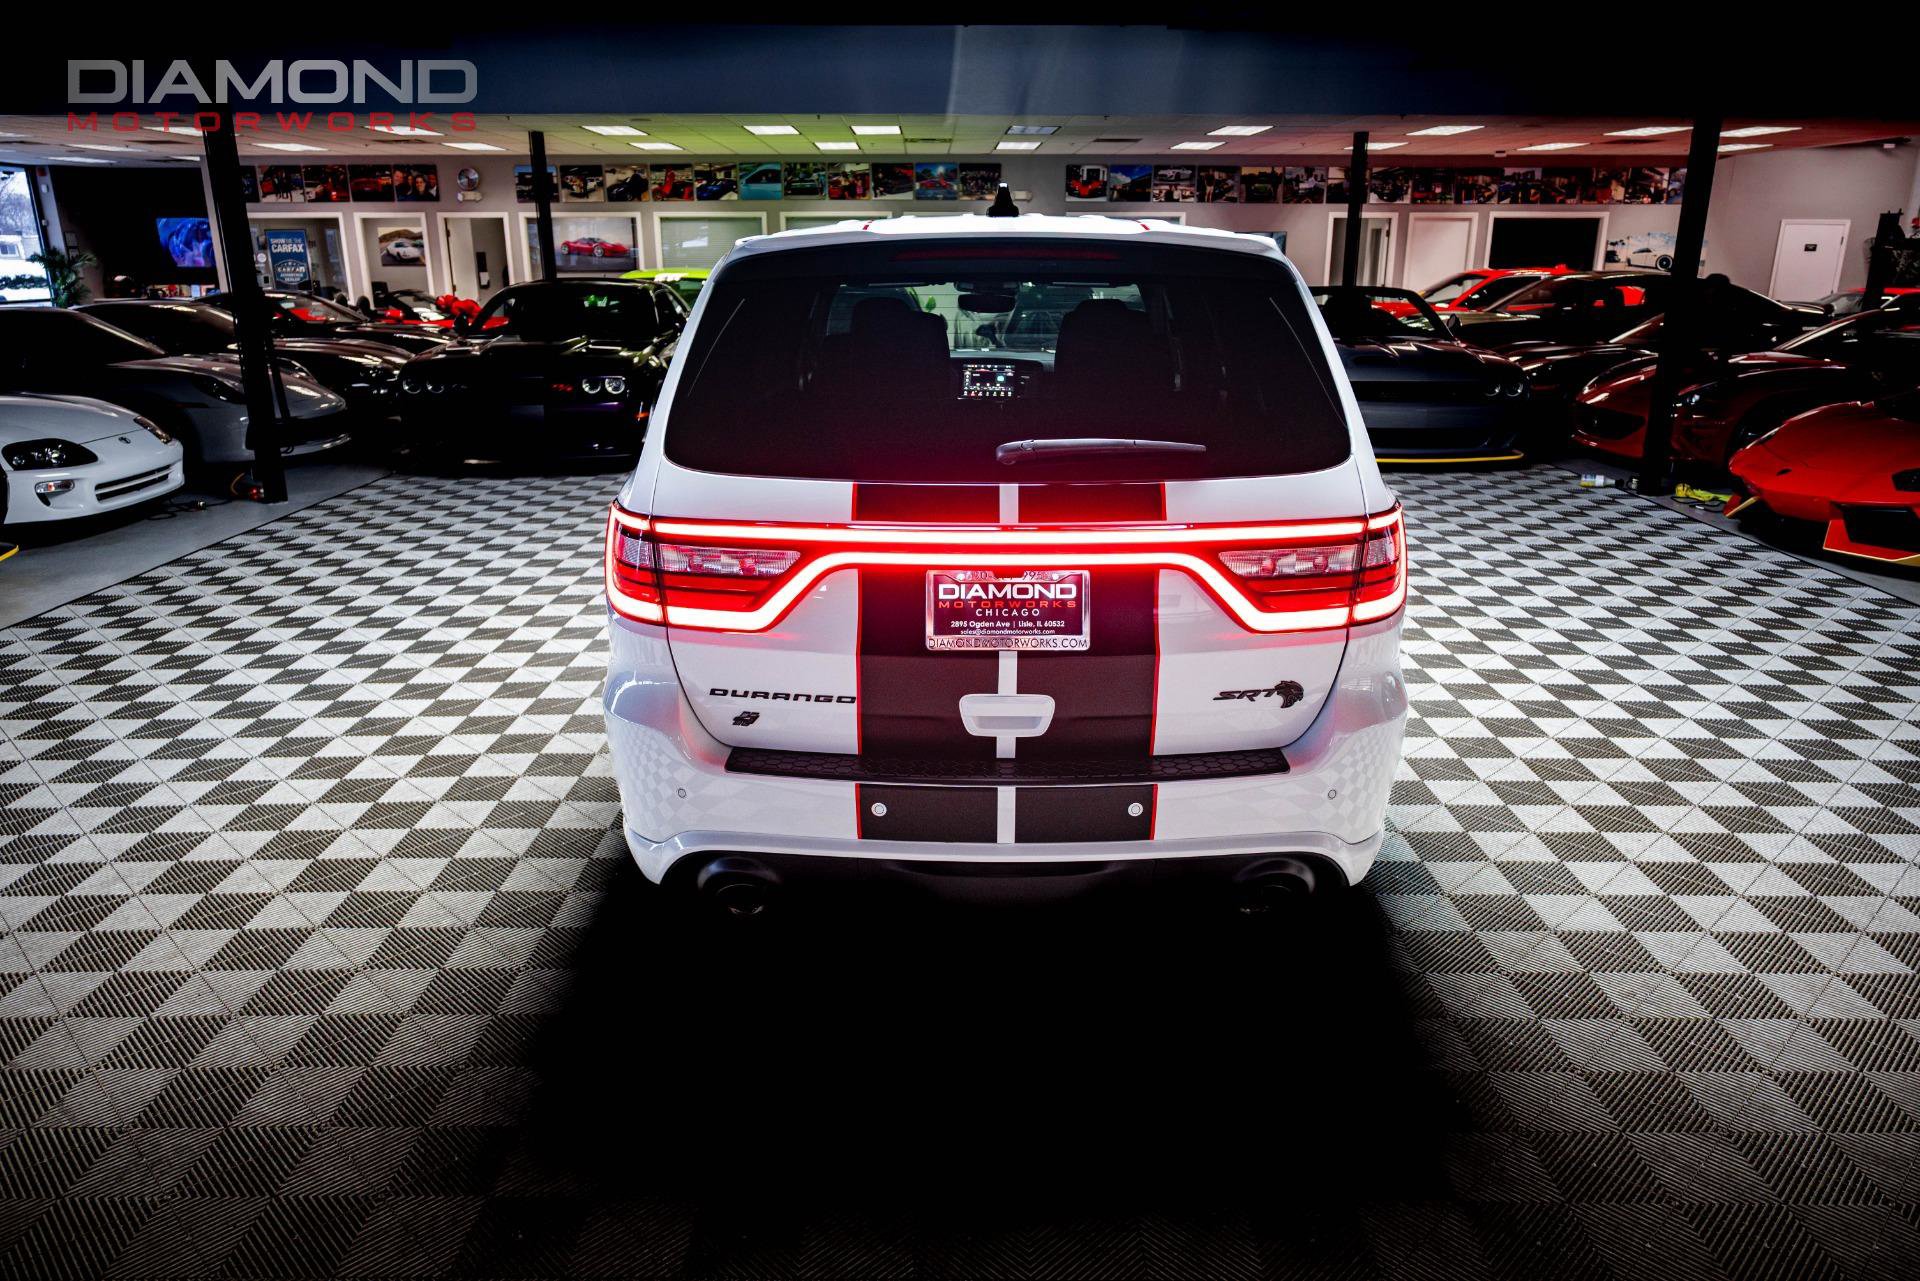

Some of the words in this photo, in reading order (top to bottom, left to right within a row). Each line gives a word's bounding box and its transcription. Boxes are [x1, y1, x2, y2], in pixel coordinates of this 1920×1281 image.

[271, 244, 304, 253] CARFAX
[938, 583, 1077, 599] DIAMOND
[938, 600, 1076, 608] MOTORWORKS
[975, 608, 1040, 617] CHICAGO
[950, 620, 968, 628] 2895
[969, 620, 994, 629] Ogden
[995, 620, 1011, 628] Ave
[1036, 620, 1043, 628] IL
[928, 638, 1088, 650] DIAMONDMOTORWORKS.COM
[709, 688, 856, 704] DURANGO
[1212, 689, 1277, 702] SRT
